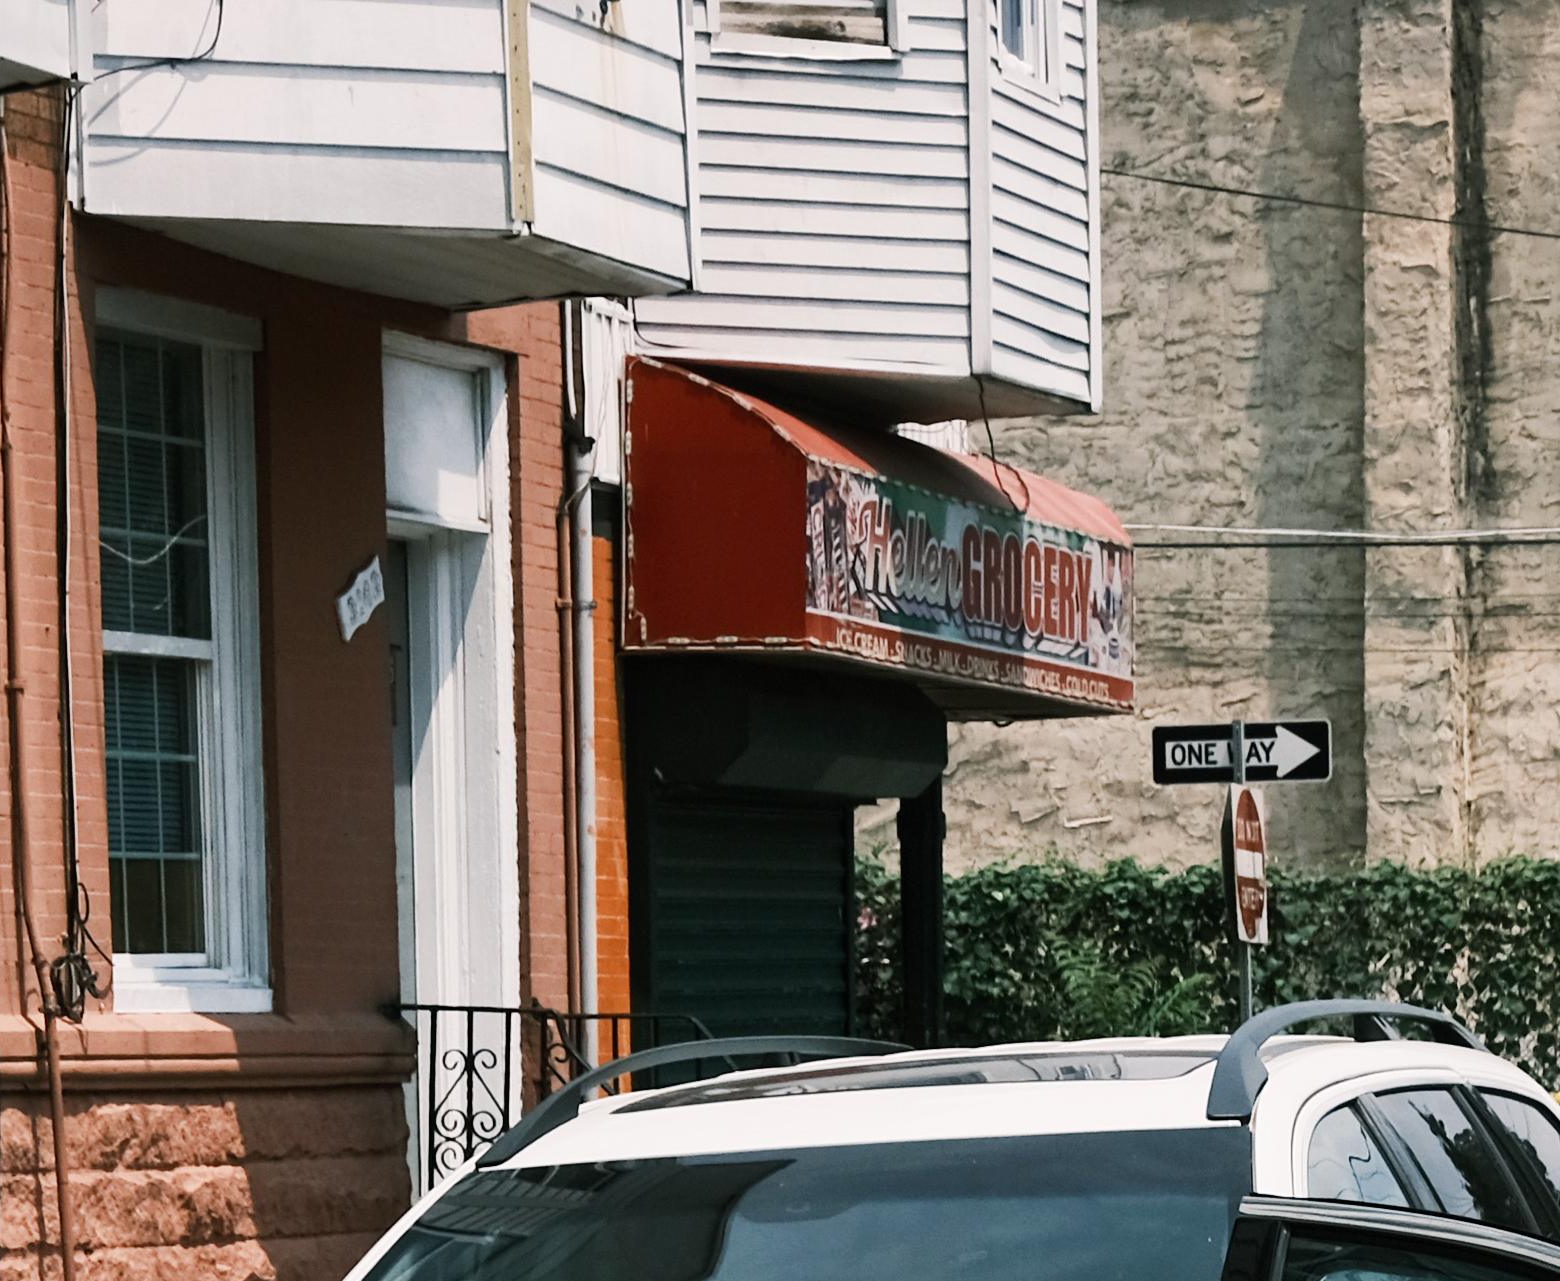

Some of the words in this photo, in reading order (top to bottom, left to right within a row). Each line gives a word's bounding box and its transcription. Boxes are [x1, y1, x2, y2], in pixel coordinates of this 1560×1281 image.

[858, 496, 963, 609] Hellen
[961, 523, 1093, 645] GROCERY
[854, 631, 889, 660] CREAM
[1171, 743, 1217, 766] ONE
